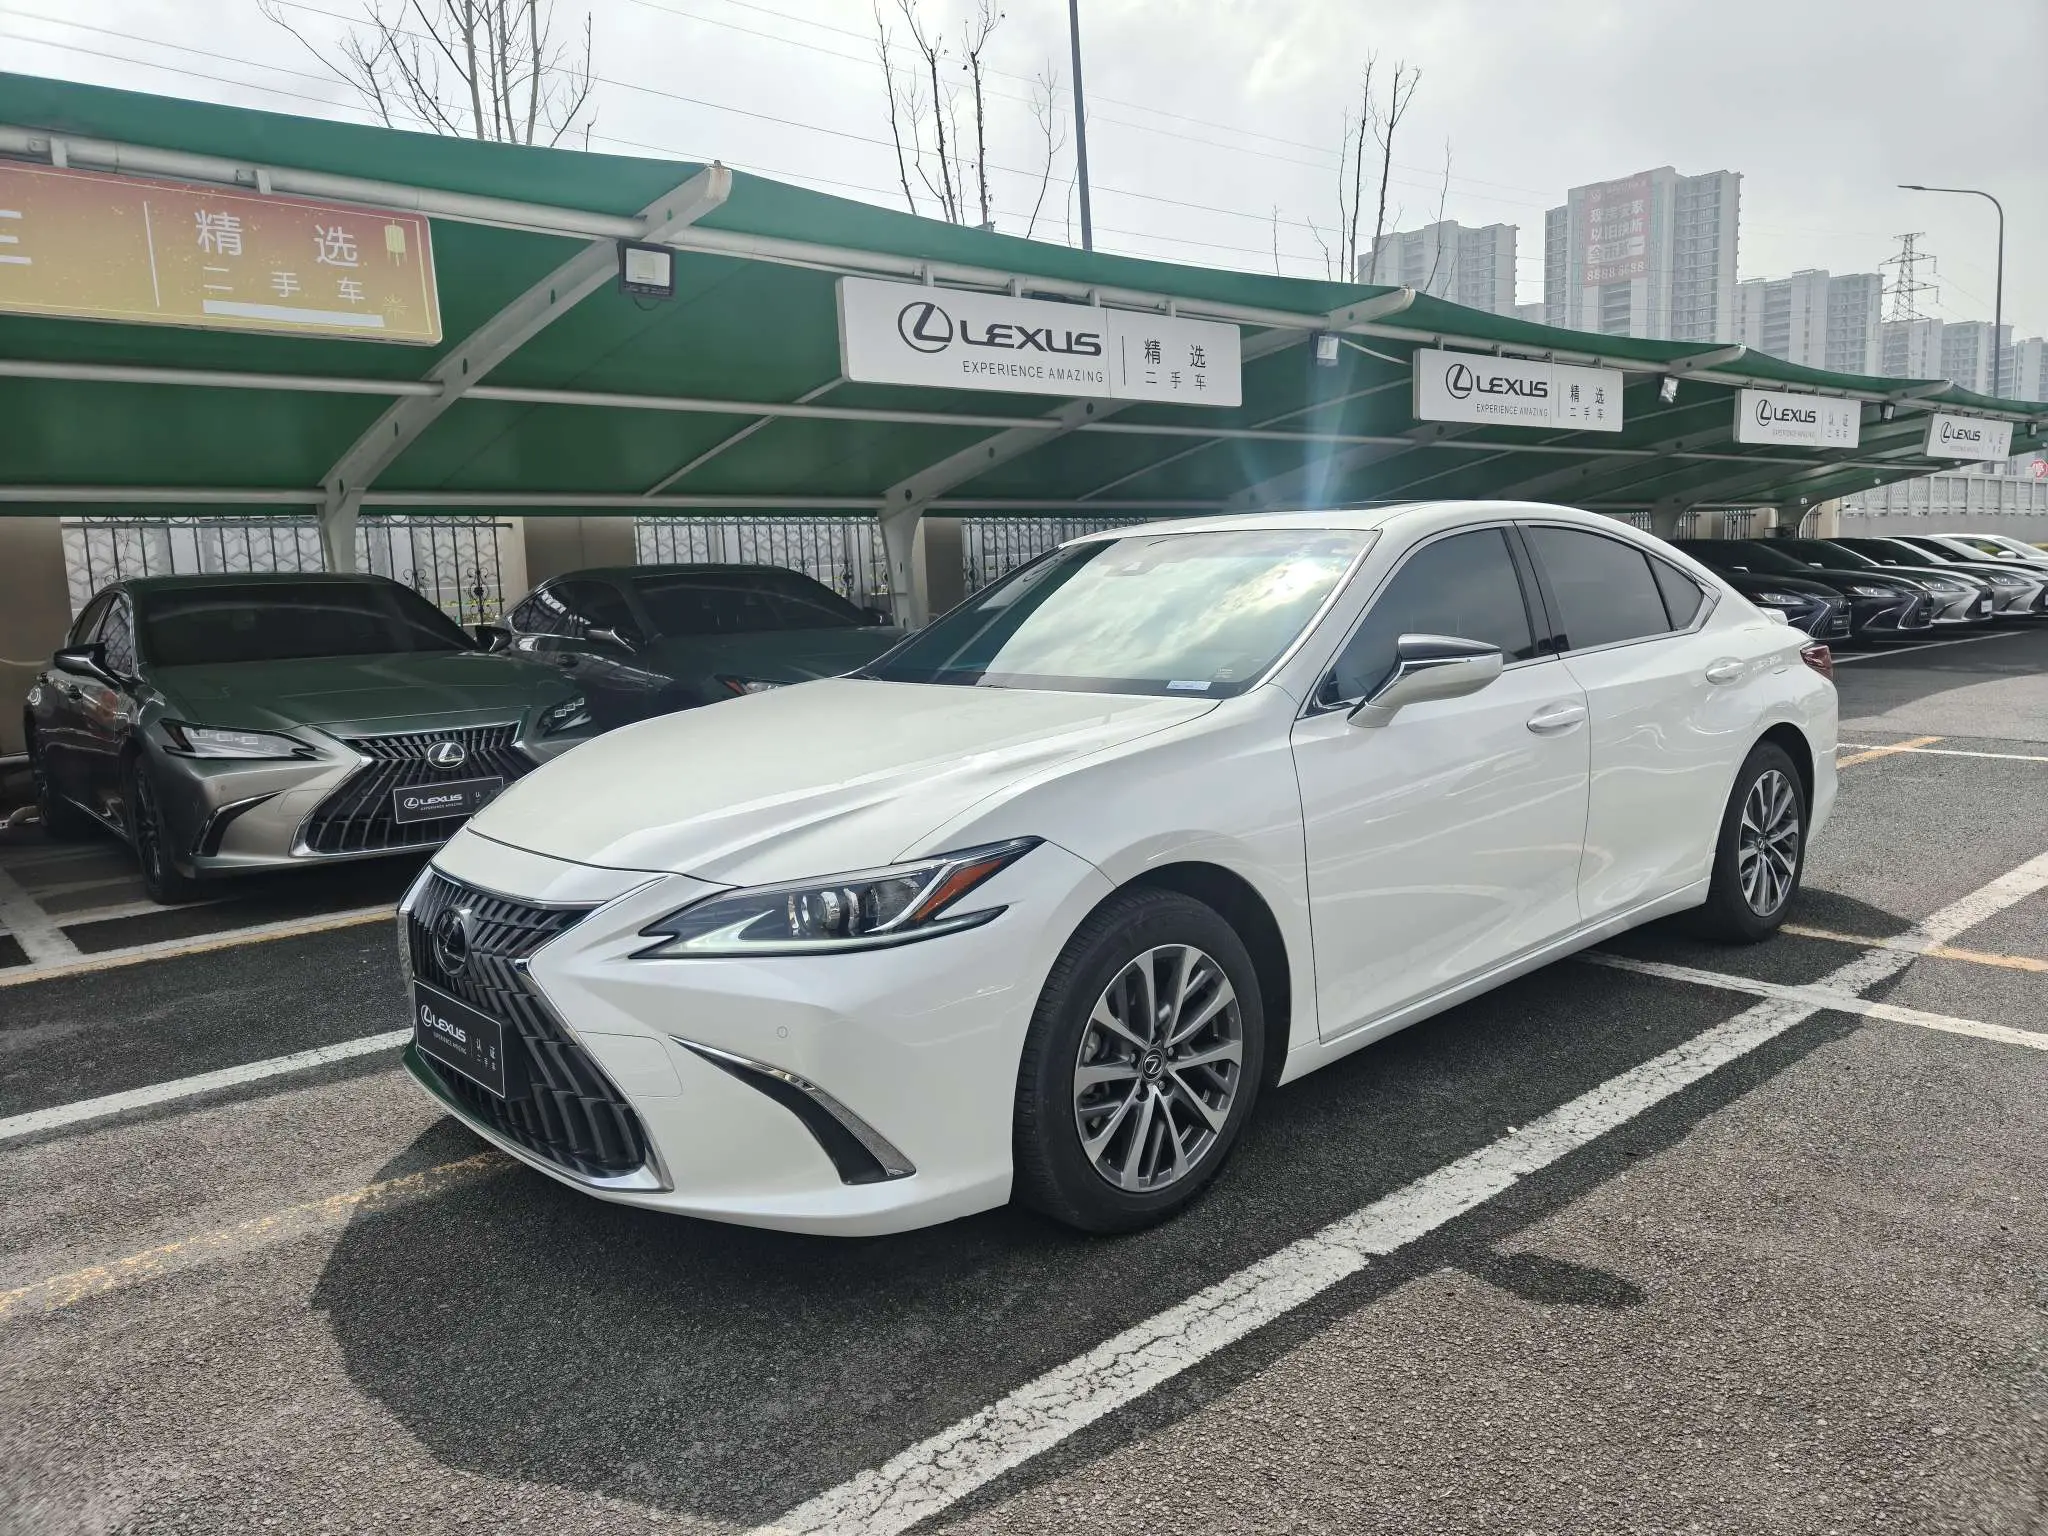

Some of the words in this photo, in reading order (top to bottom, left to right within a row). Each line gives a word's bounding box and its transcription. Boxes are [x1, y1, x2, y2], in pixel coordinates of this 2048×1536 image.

[195, 211, 359, 268] 精选
[203, 265, 366, 304] 二手车
[959, 319, 1102, 357] LEXUS
[1143, 338, 1207, 369] 精选
[962, 360, 1044, 379] EXPERIENCE
[1048, 367, 1104, 384] AMAZING
[1145, 370, 1207, 391] 二手车
[1476, 375, 1548, 398] LEXUS
[1476, 403, 1518, 415] EXPERIENCE
[1519, 406, 1549, 417] AMAZING
[1773, 407, 1816, 424] LEXUS
[1952, 429, 1981, 441] LEXUS
[420, 794, 462, 805] LEXUS
[432, 1014, 467, 1043] LEXUS
